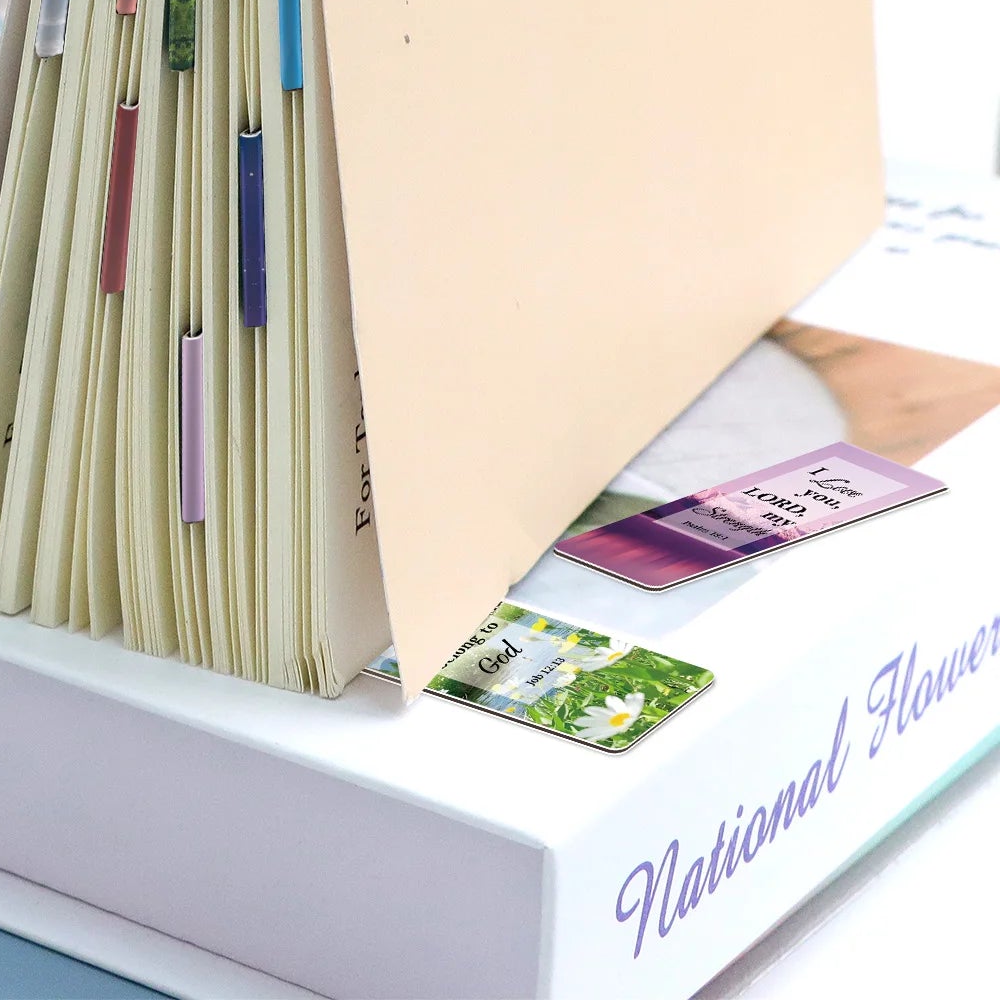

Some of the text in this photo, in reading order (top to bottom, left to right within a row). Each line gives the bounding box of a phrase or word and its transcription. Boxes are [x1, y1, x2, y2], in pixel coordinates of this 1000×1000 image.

[808, 467, 864, 498] I Love
[742, 486, 808, 518] LORD,
[794, 489, 841, 510] you,
[691, 506, 773, 537] Strength
[760, 511, 797, 527] my
[480, 622, 499, 634] to
[478, 638, 523, 675] God
[526, 657, 566, 687] Job 12:13
[615, 695, 851, 960] National
